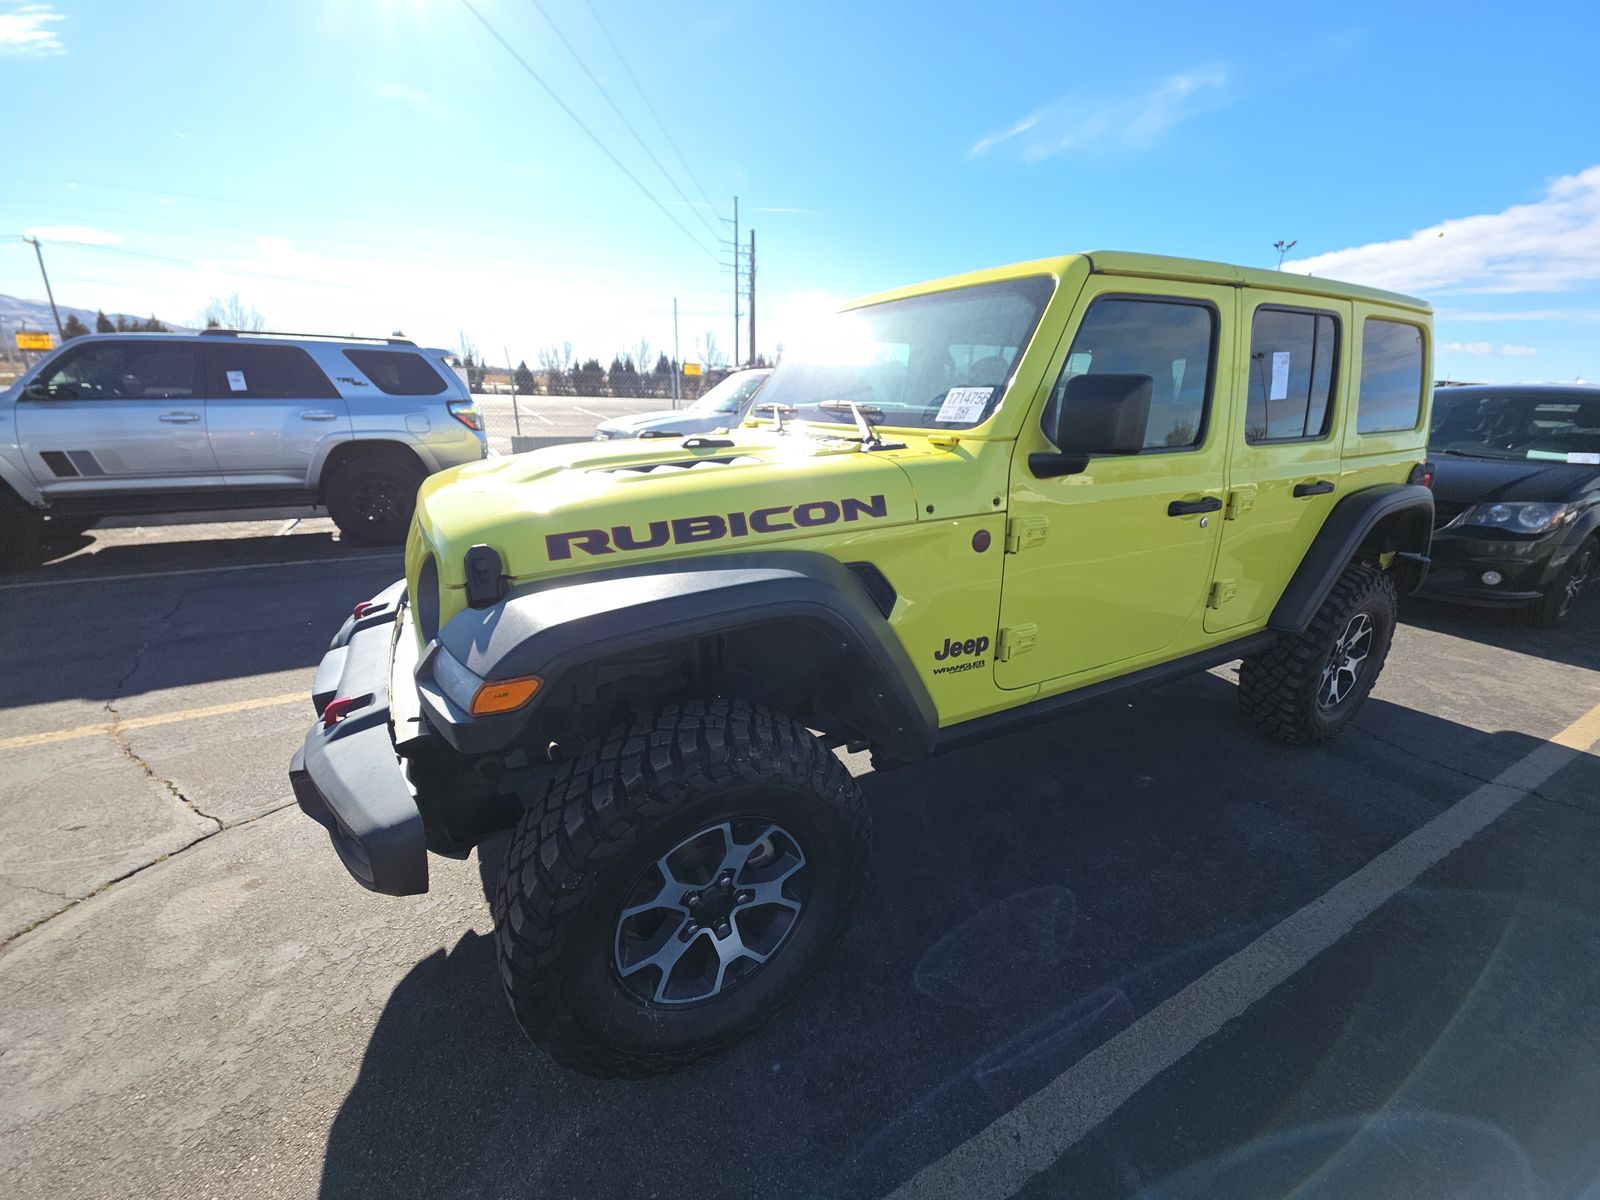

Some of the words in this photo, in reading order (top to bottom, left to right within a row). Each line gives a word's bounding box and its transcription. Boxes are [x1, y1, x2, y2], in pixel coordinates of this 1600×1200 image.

[947, 391, 991, 405] 1714756
[545, 494, 888, 561] RUBICON
[934, 636, 989, 660] Jeep
[933, 660, 985, 675] WRANGLER
